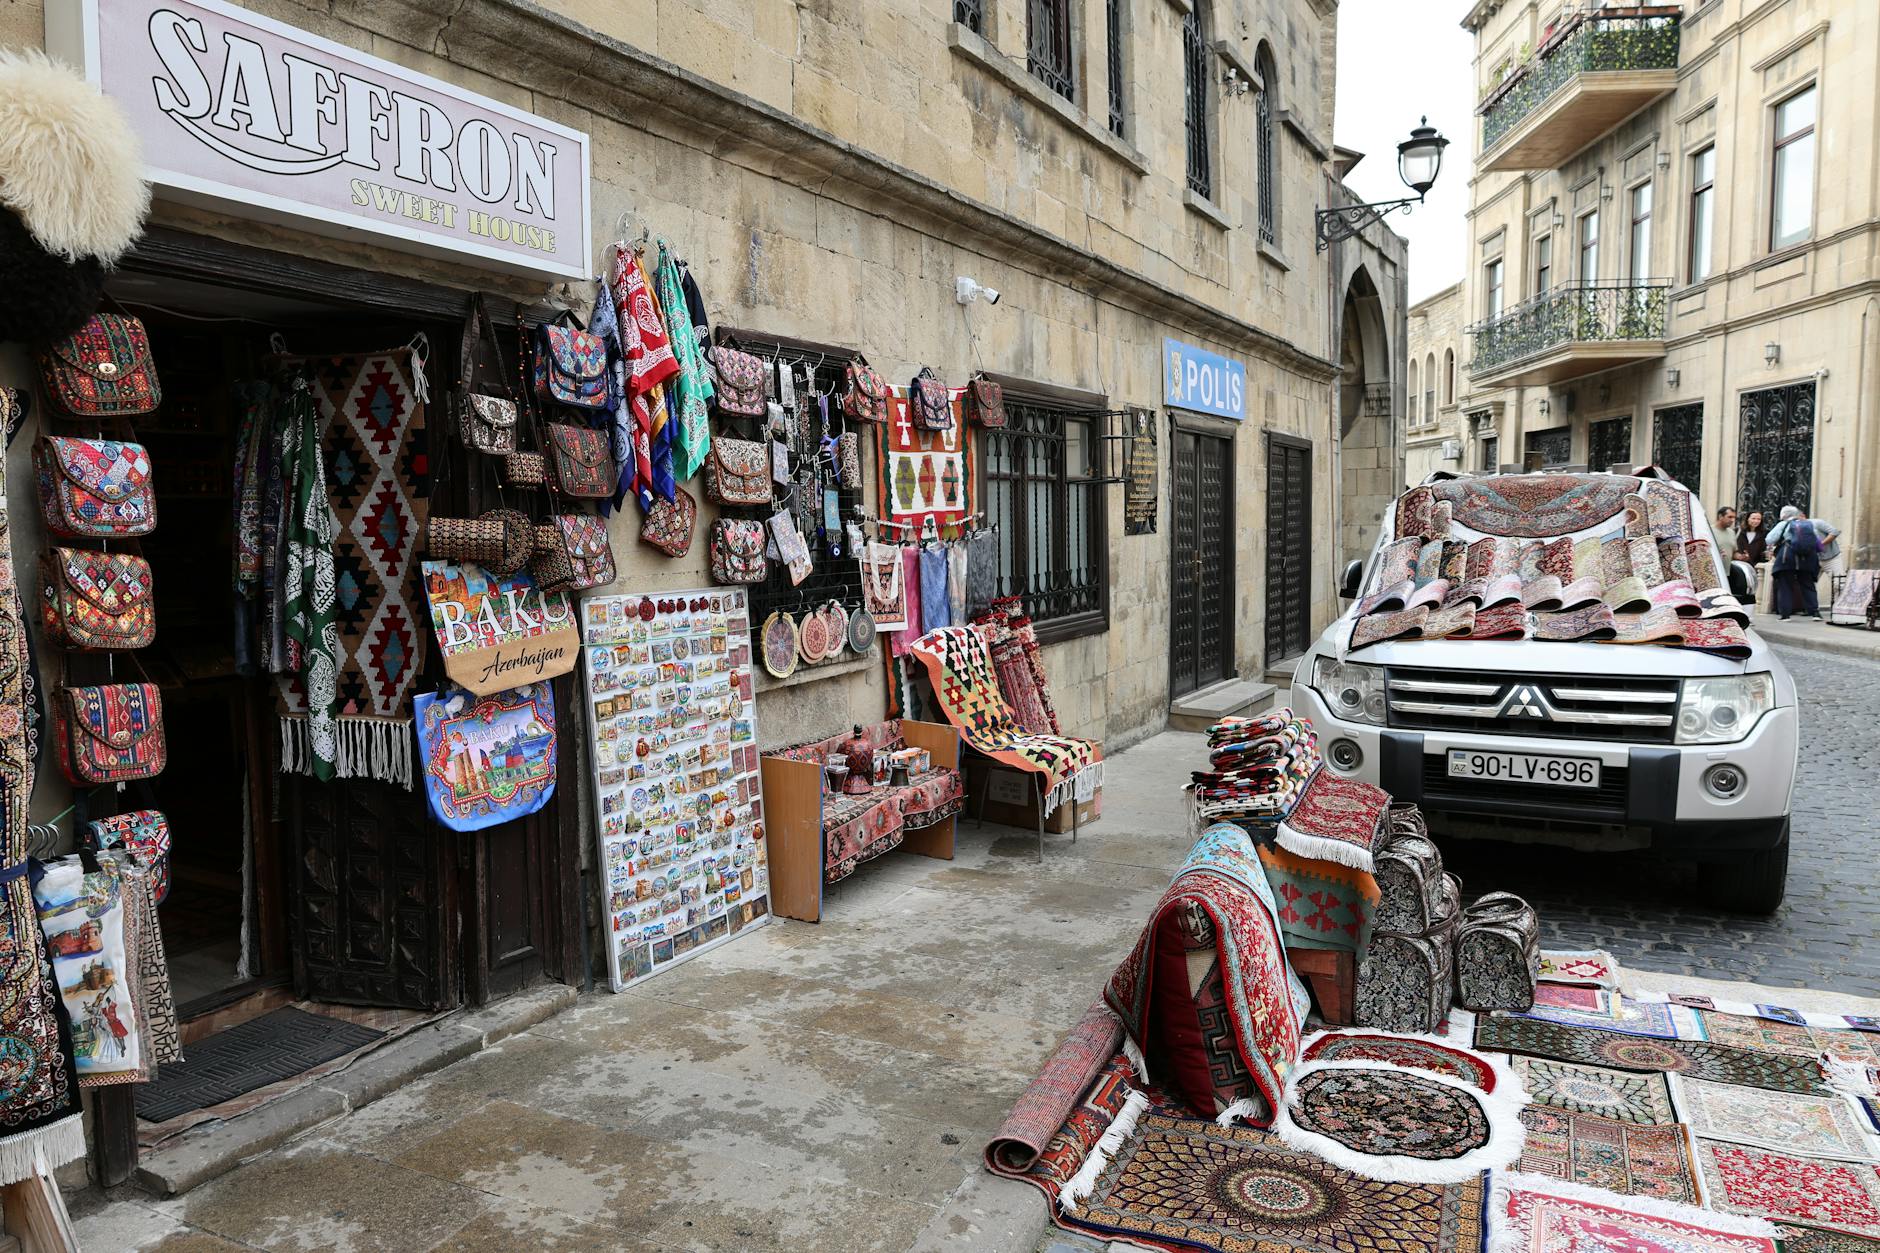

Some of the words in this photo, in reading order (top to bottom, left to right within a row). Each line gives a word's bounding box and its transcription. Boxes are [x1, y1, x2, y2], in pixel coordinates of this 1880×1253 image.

[148, 8, 557, 221] SAFFRON
[350, 177, 458, 229] SWEET
[467, 209, 557, 254] HOUSE
[1186, 359, 1242, 413] POLİS
[435, 586, 569, 648] BAKU
[478, 647, 565, 683] Azerbaijan
[1470, 754, 1594, 784] 90-LV-696
